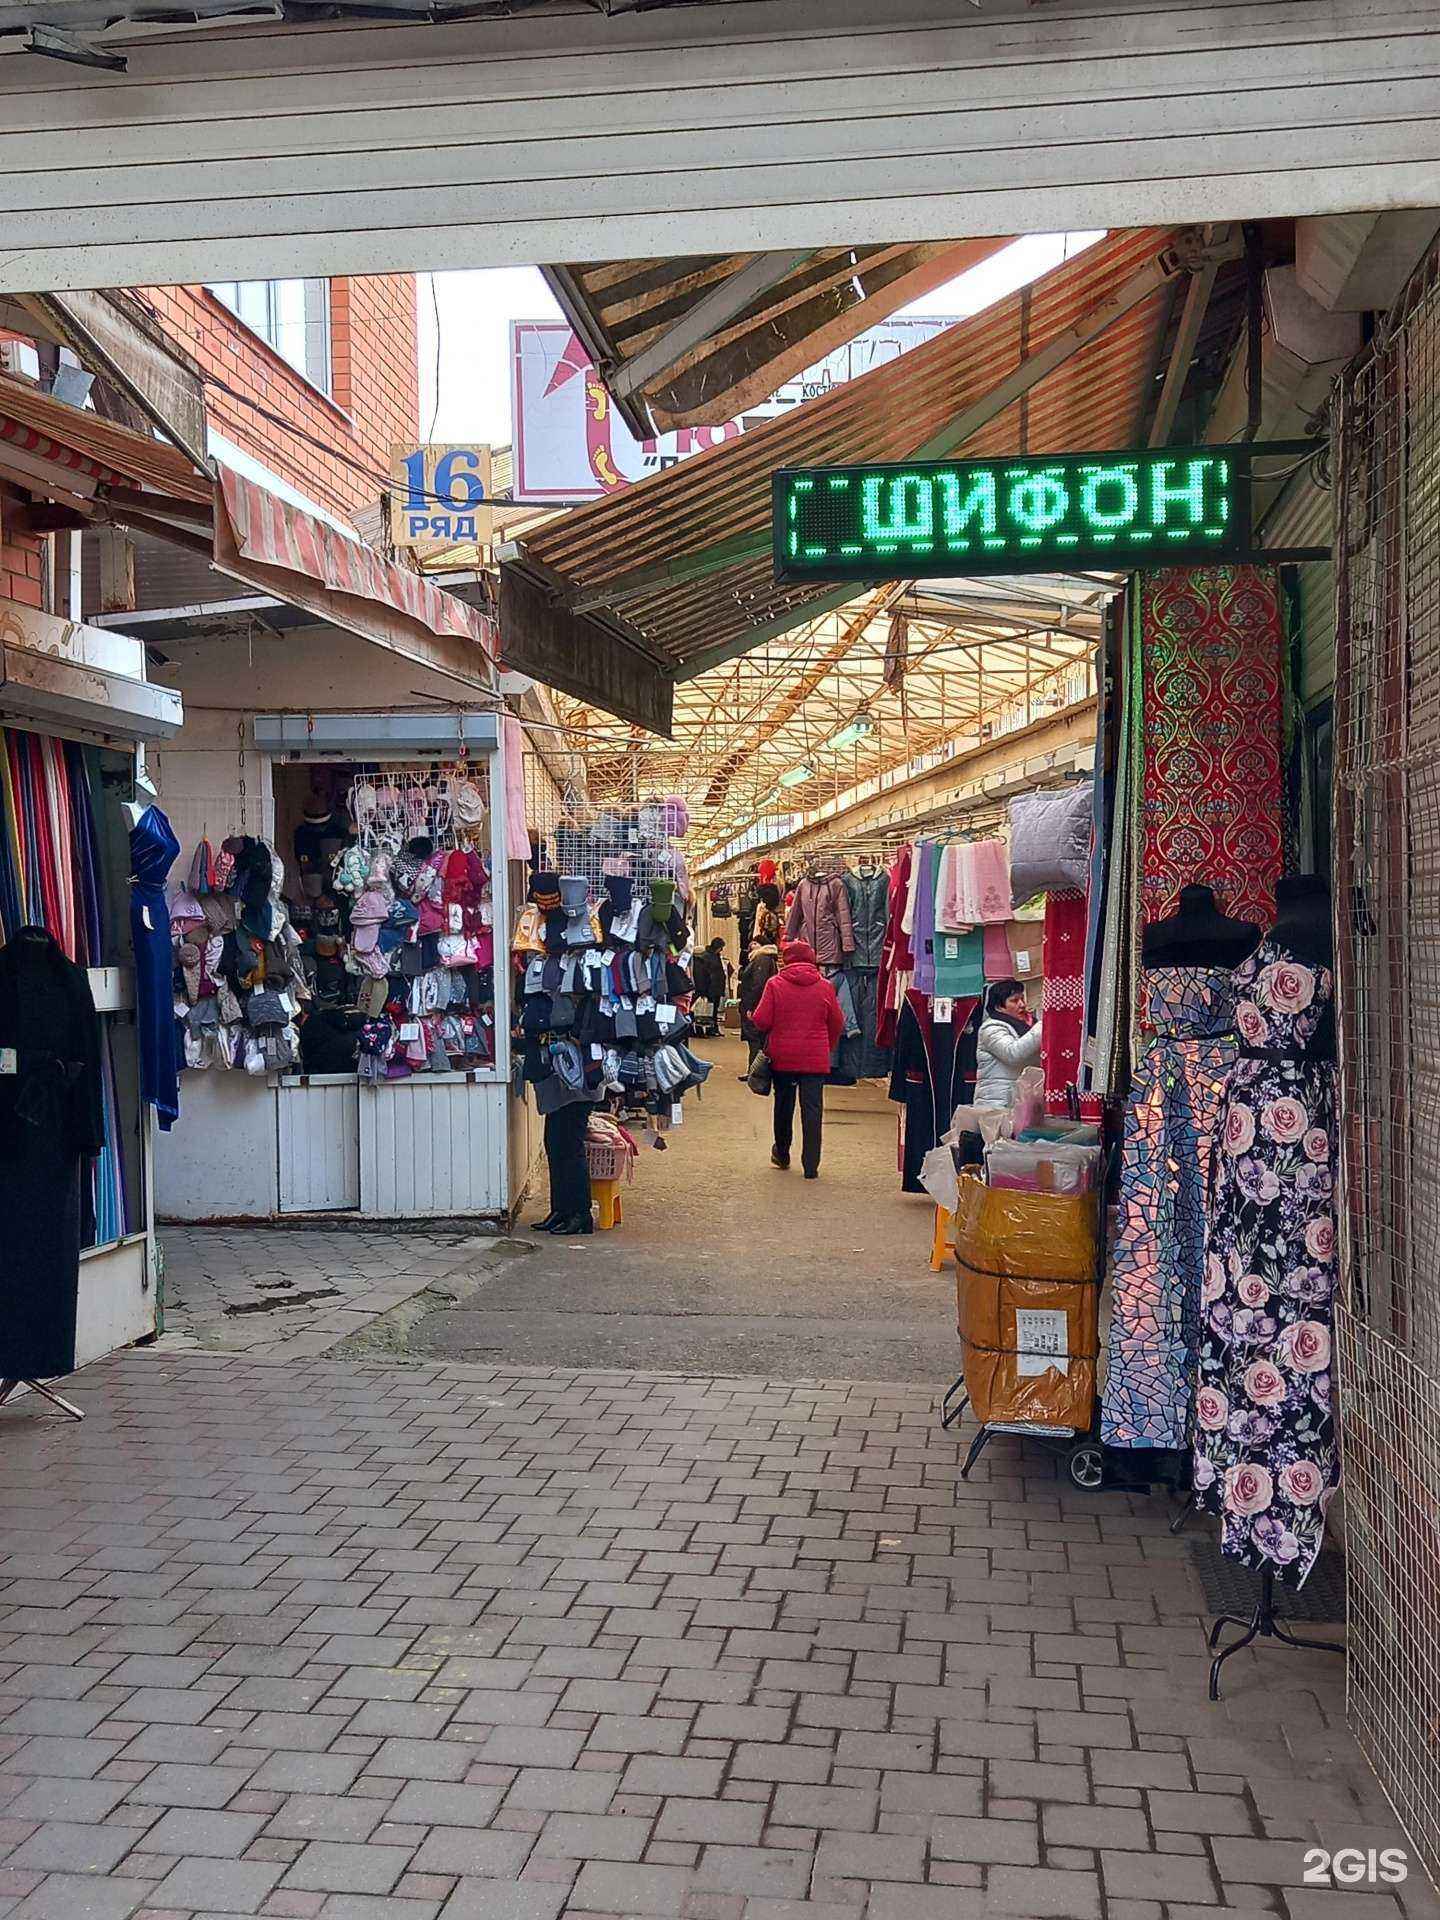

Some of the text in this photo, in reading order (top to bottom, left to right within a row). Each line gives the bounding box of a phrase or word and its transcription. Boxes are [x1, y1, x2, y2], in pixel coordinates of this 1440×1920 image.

[400, 450, 484, 512] 16
[862, 460, 1213, 541] ШИФОН
[409, 516, 478, 541] РЯД
